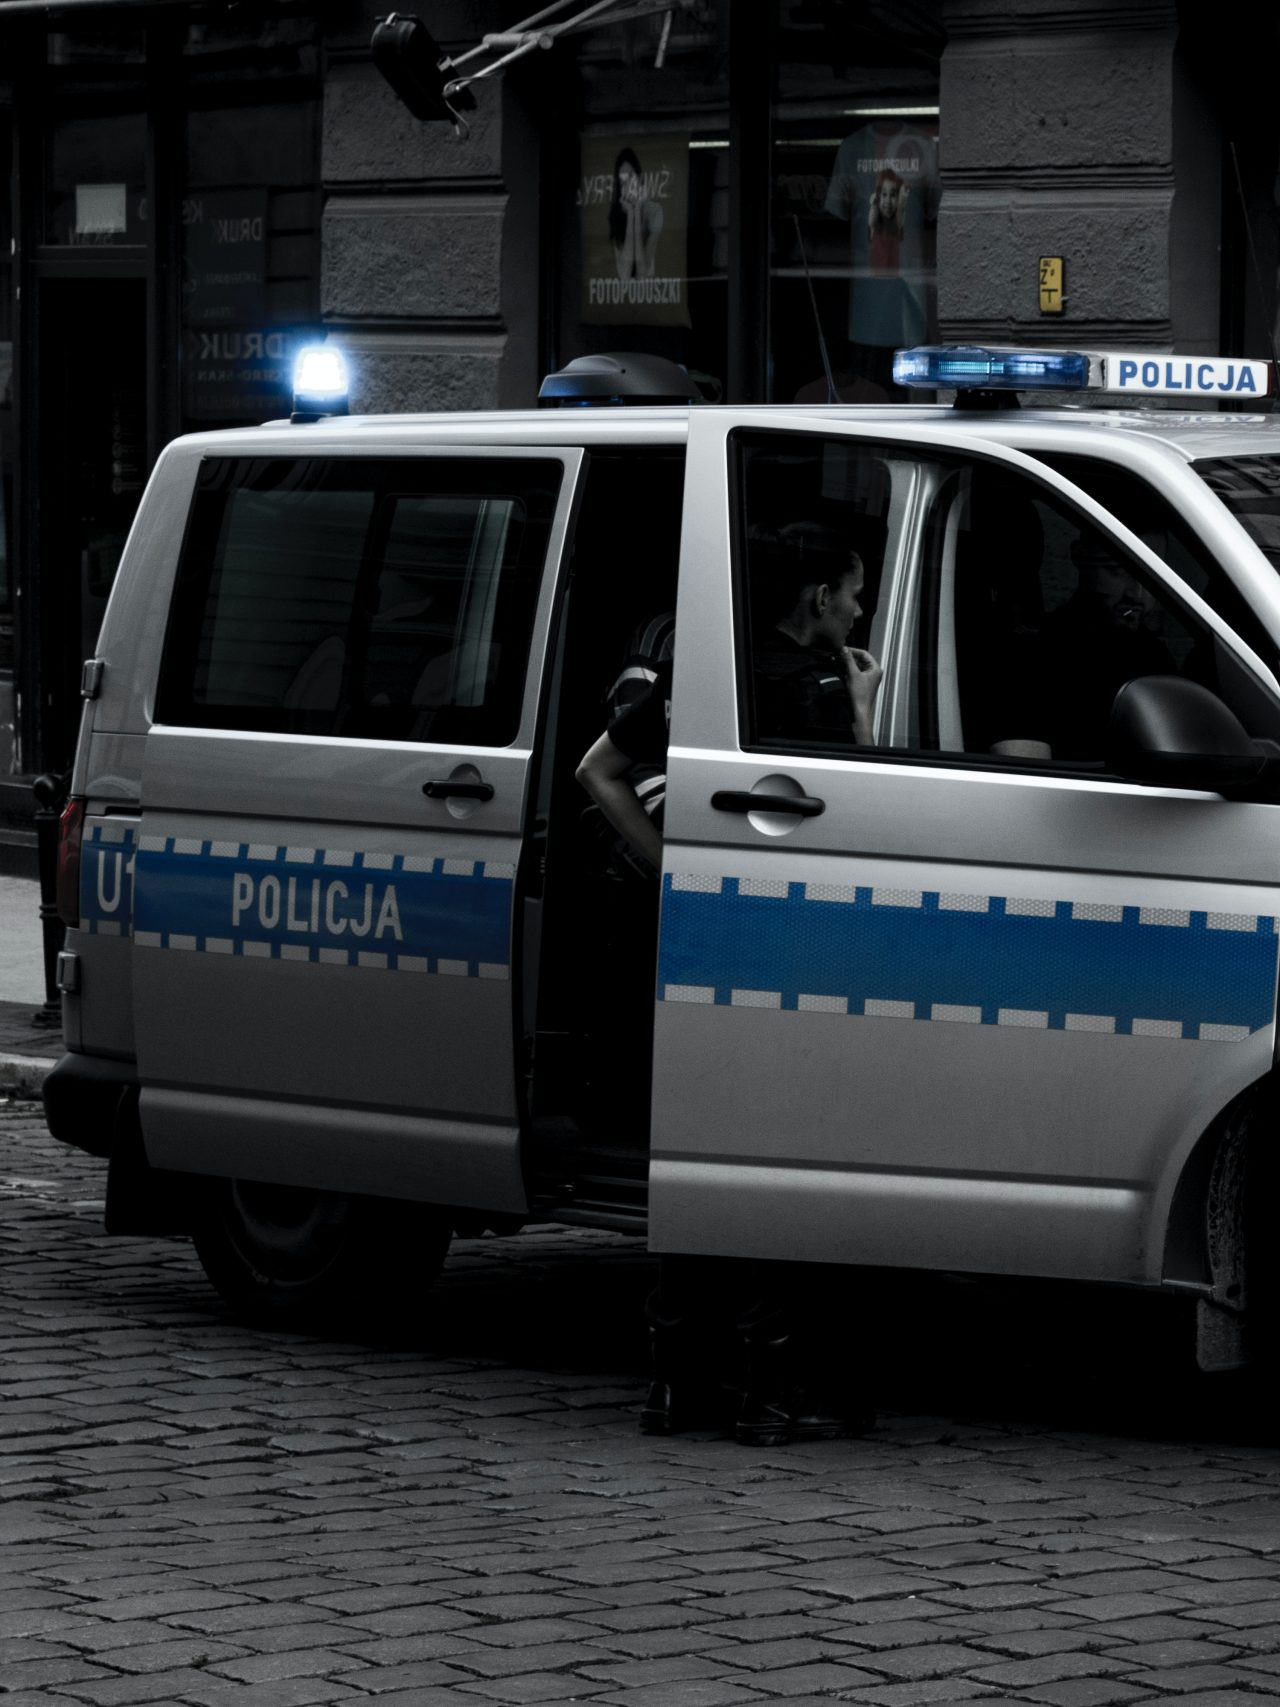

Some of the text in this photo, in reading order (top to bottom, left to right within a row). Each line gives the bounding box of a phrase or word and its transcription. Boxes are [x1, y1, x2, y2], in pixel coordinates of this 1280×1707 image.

[589, 277, 681, 305] FOTOPODUSZKI
[1119, 359, 1257, 392] POLICJA
[232, 872, 404, 941] POLICJA
